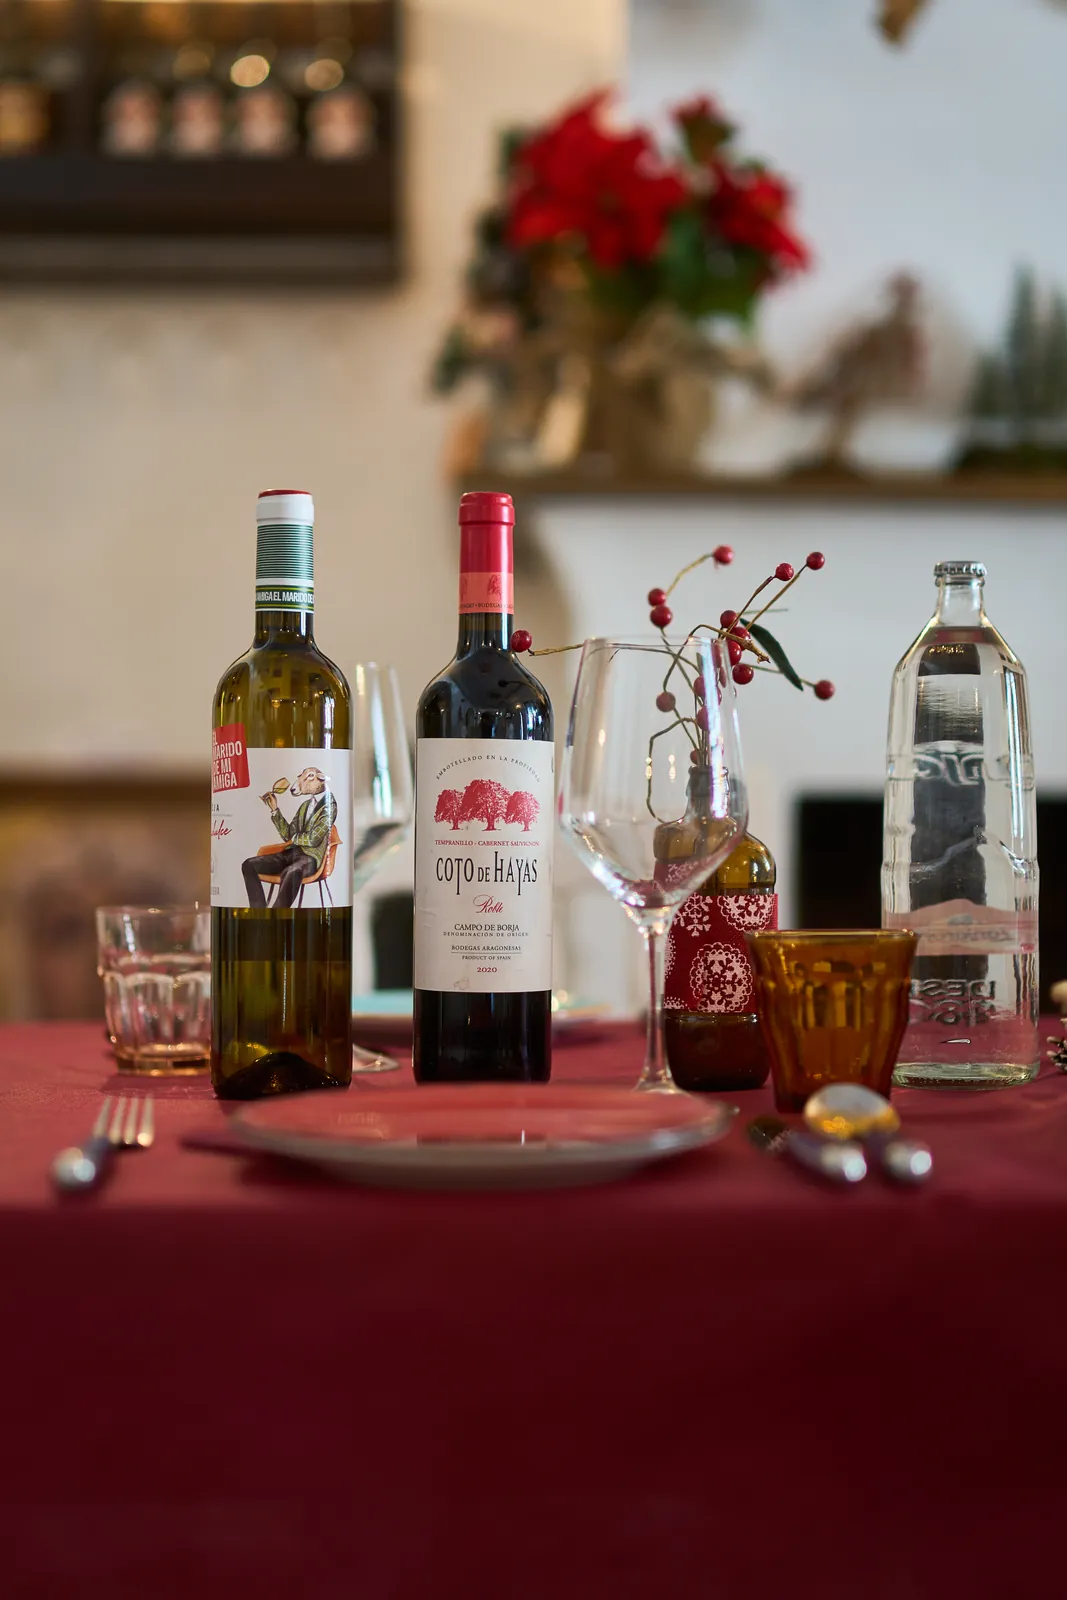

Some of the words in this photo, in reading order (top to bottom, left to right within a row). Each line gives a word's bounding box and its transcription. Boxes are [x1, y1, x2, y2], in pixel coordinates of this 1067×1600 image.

[273, 592, 281, 601] EL
[282, 592, 306, 603] MARIDO
[220, 757, 232, 773] MI
[436, 755, 483, 780] EMBOTELLADO
[436, 857, 475, 896] COTO
[477, 867, 491, 882] DE
[494, 851, 538, 896] HAYAS
[472, 894, 504, 913] Roble
[454, 923, 483, 931] CAMPO
[497, 924, 520, 932] BORJA
